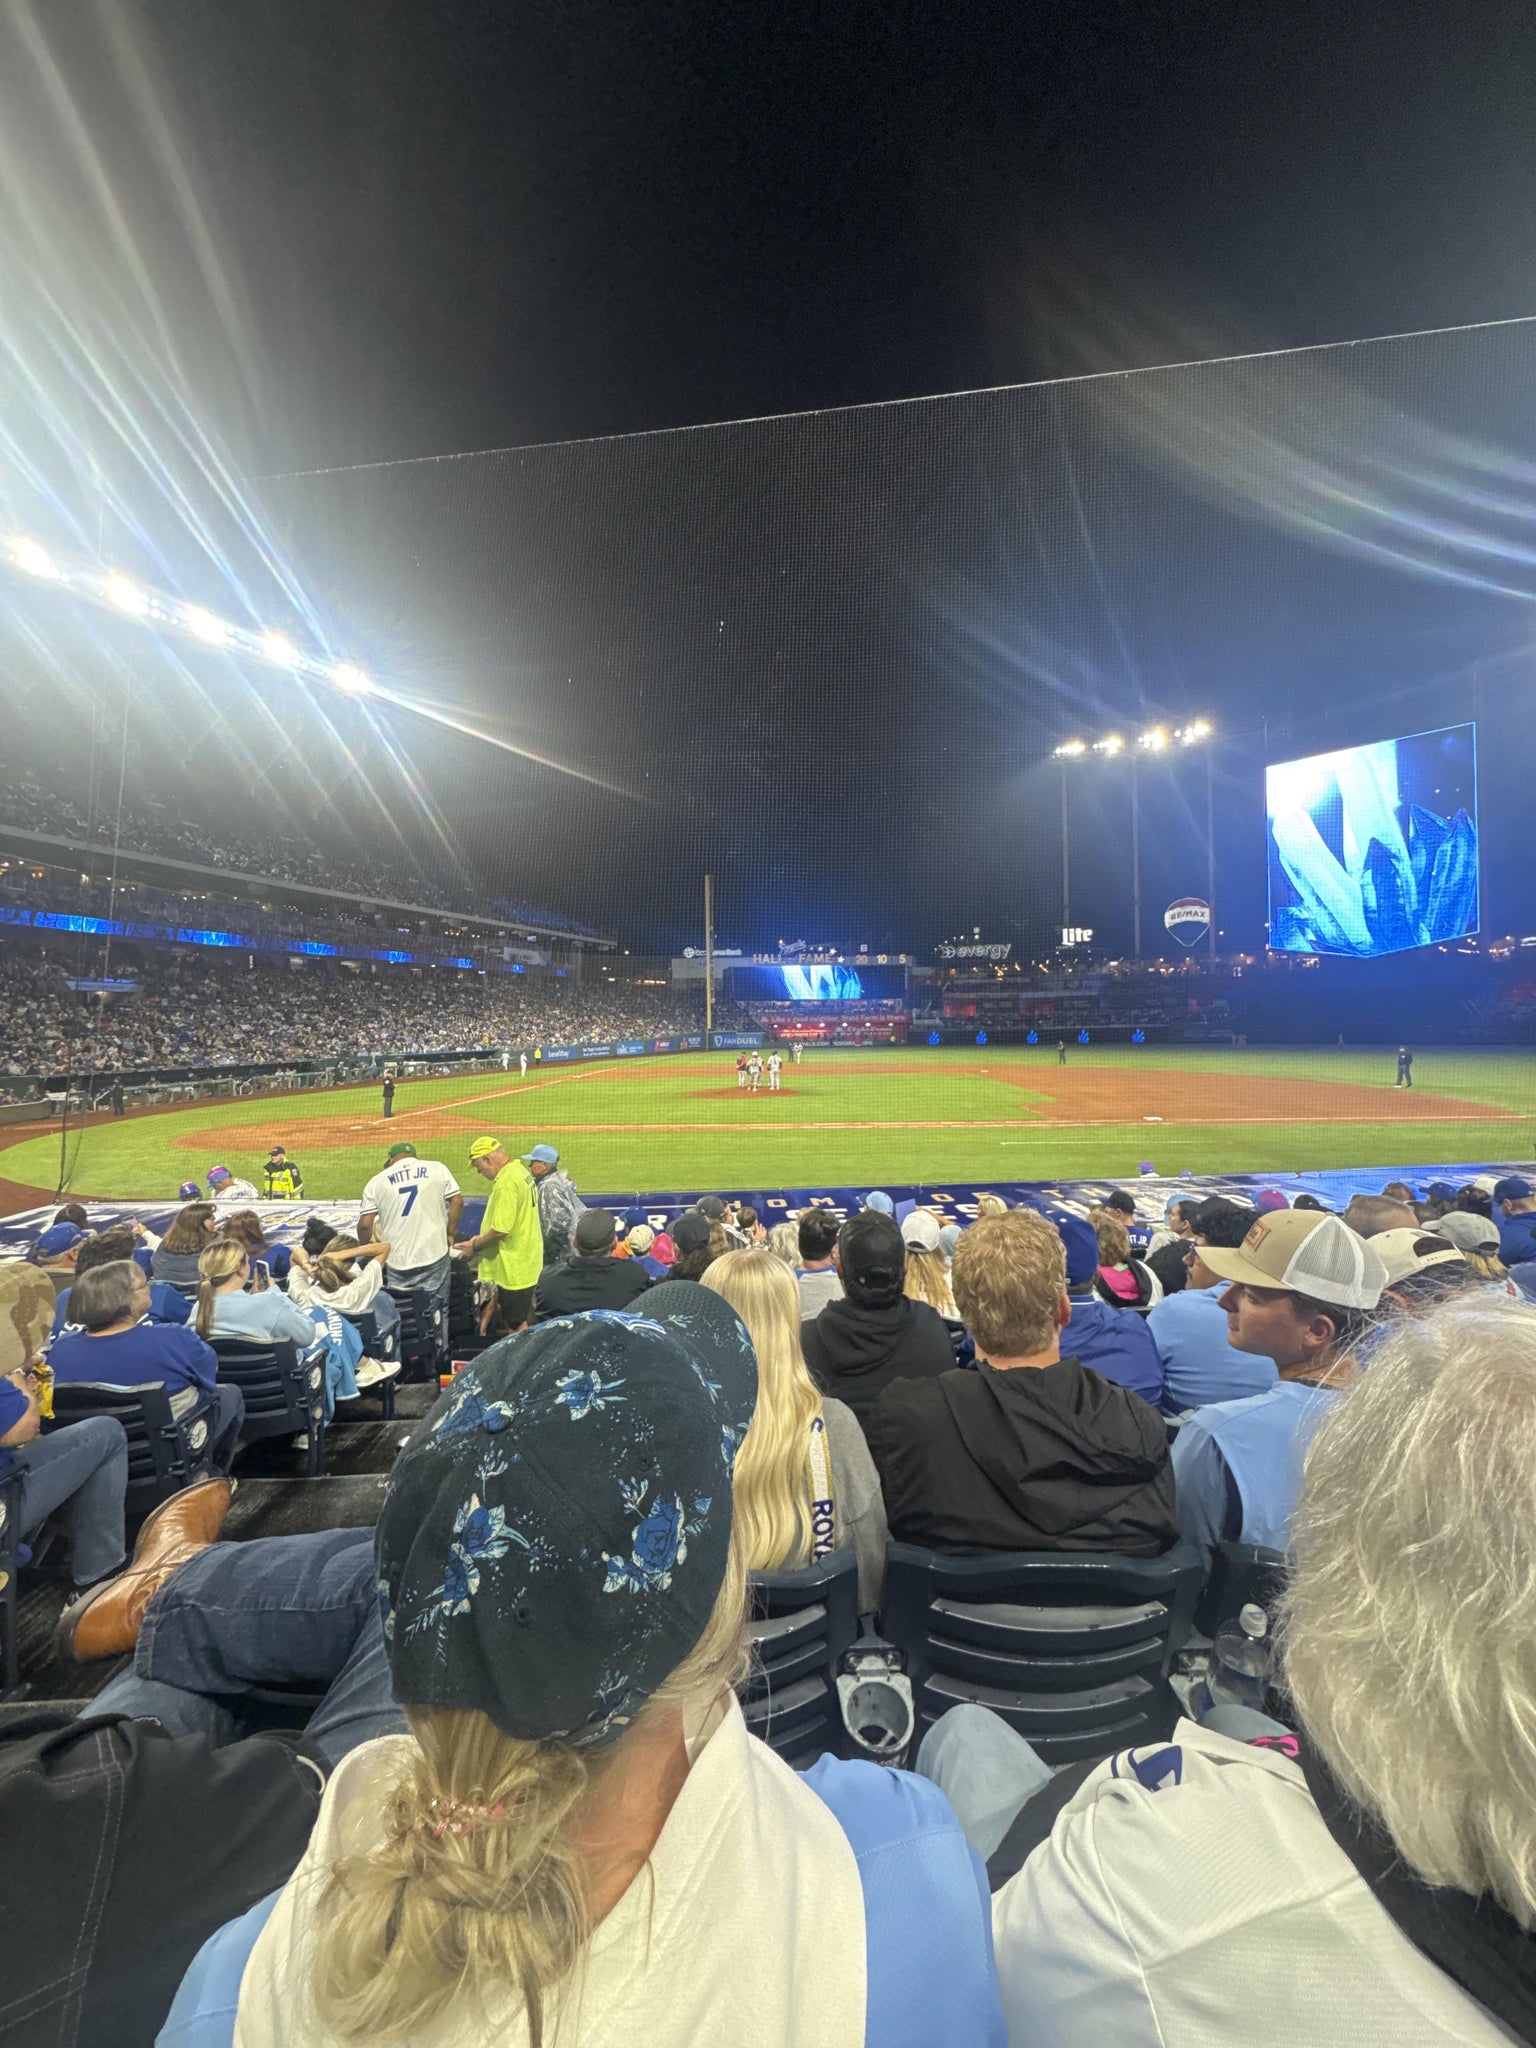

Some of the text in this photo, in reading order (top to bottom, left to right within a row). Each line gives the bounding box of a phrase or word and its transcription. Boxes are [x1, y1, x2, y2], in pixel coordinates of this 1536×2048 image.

[1170, 910, 1206, 920] RE/MAX
[1062, 928, 1093, 946] Lite
[799, 953, 833, 964] FAME
[876, 953, 888, 964] 10
[899, 953, 906, 964] 5
[958, 943, 1012, 960] evergy
[723, 1037, 759, 1045] FANDUEL
[387, 1167, 429, 1185] WITT JR.
[398, 1184, 419, 1217] 7
